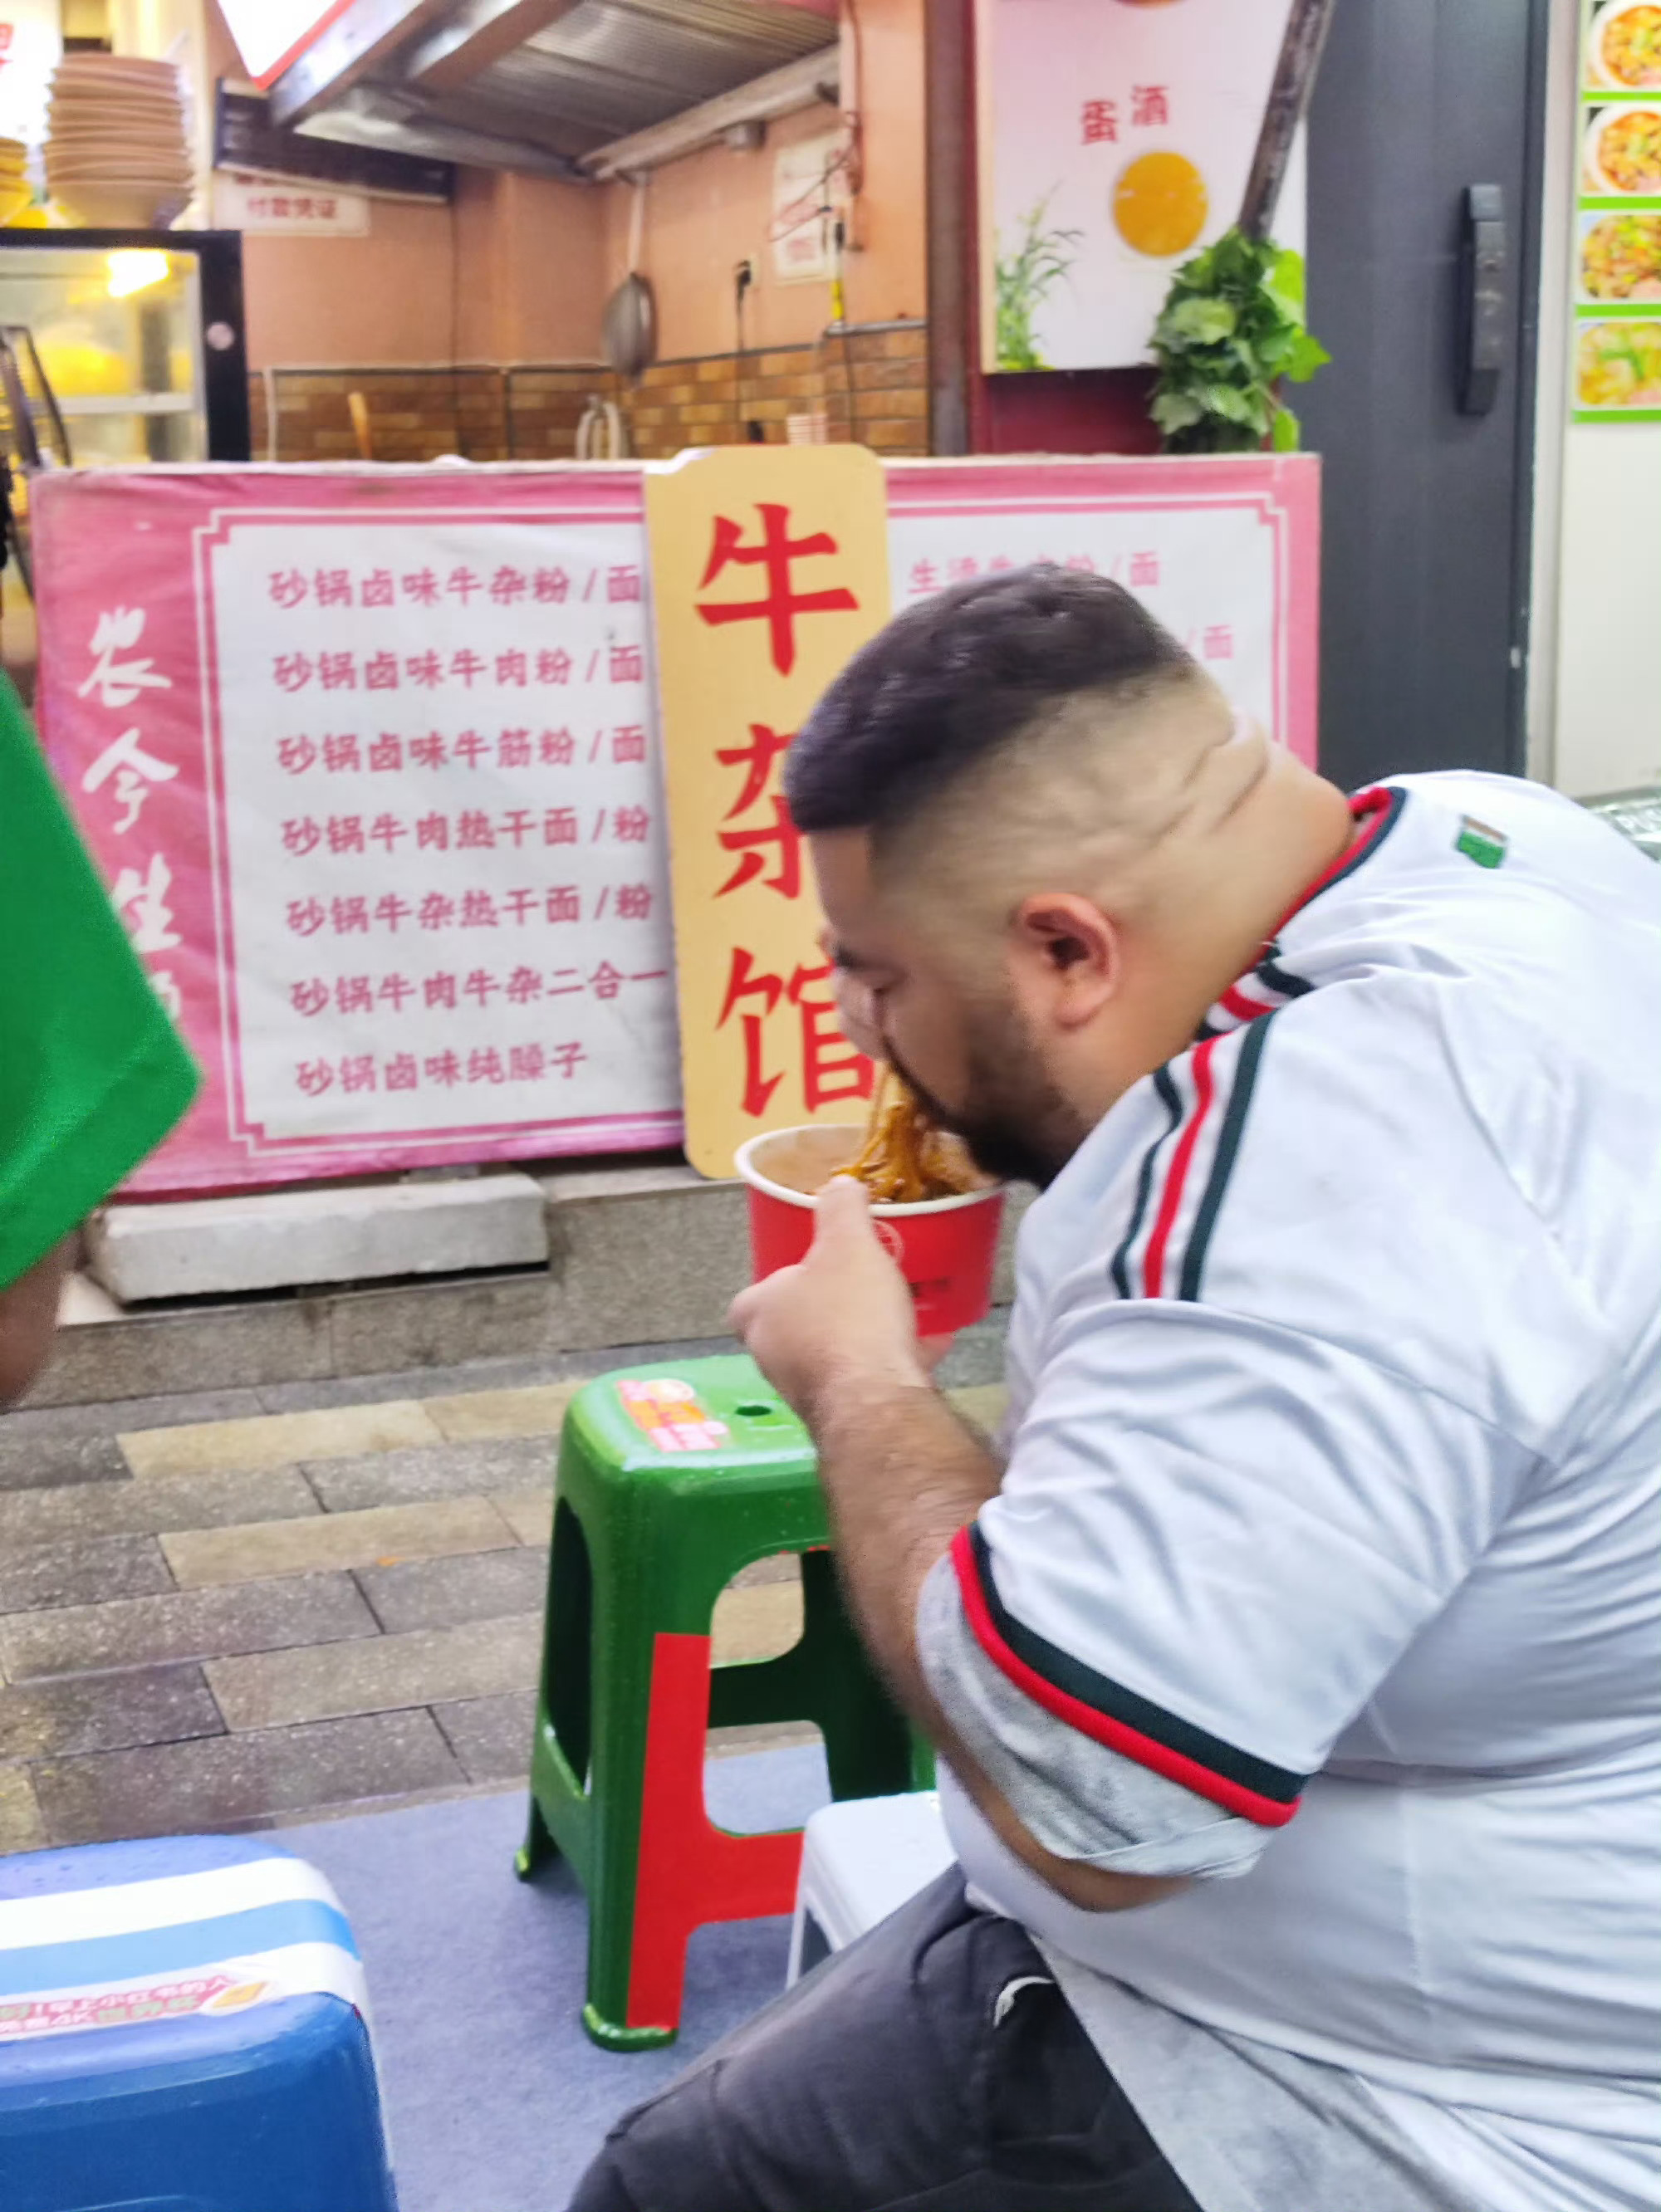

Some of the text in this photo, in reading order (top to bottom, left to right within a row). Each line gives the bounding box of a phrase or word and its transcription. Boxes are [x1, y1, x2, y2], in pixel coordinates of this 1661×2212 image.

[1081, 85, 1169, 146] 蛋酒
[267, 565, 642, 609] 砂锅卤味牛杂粉/面
[272, 644, 644, 692] 砂锅卤味牛肉粉/面
[277, 725, 646, 775] 砂锅卤味牛筋粉/面
[281, 805, 650, 857] 砂锅牛肉热干面/粉
[695, 503, 876, 1117] 牛杂馆
[286, 883, 653, 937] 砂锅牛杂热干面/粉
[291, 960, 669, 1017] 砂锅牛肉牛杂二合一
